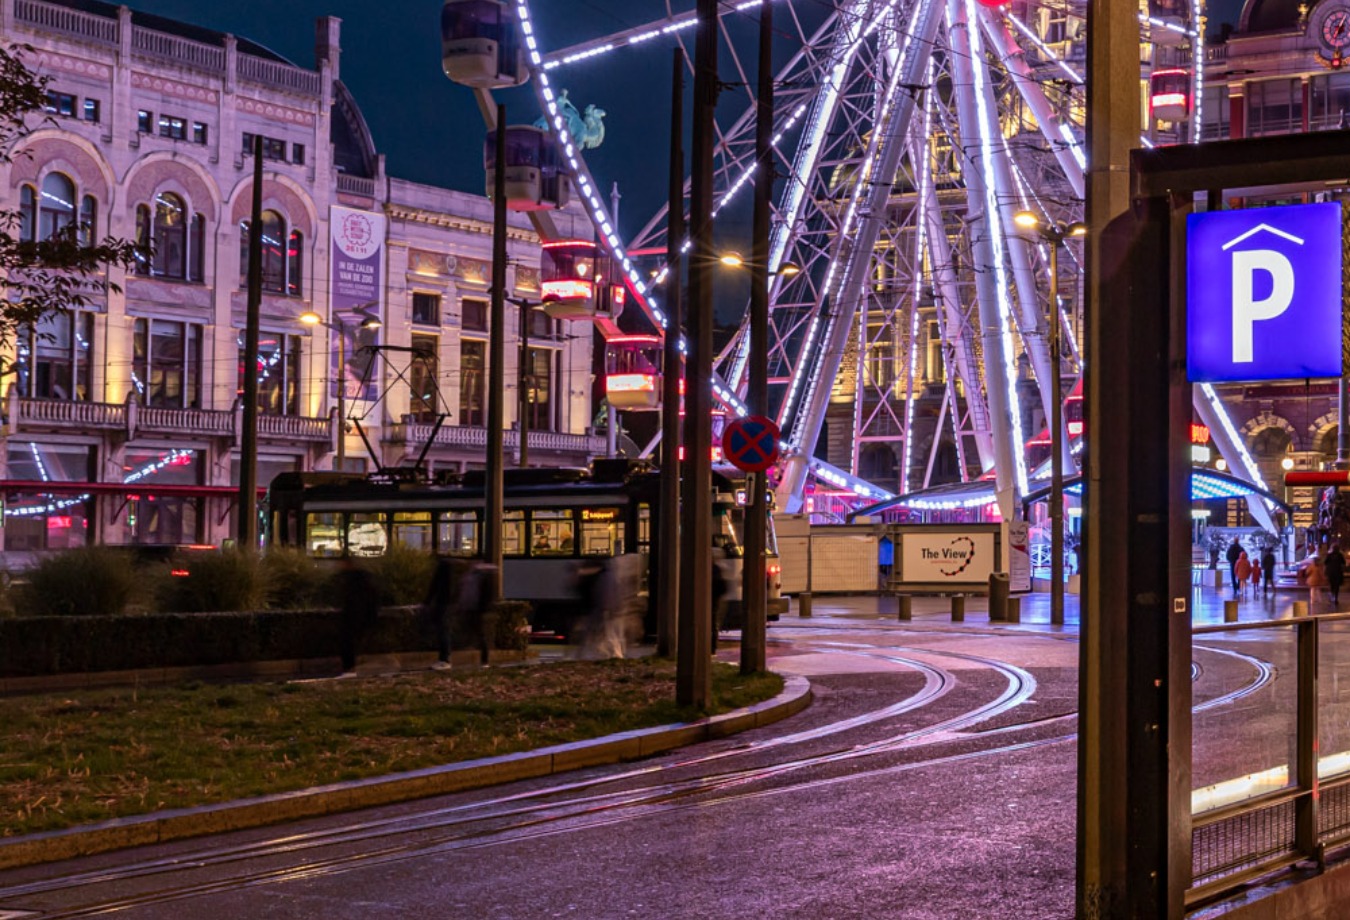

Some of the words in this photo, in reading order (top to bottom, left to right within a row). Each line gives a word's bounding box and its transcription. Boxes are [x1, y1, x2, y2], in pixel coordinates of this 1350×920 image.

[338, 261, 346, 270] IN
[346, 262, 355, 271] DE
[355, 264, 374, 274] ZALEN
[339, 271, 352, 281] VAN
[353, 273, 361, 282] DE
[1232, 249, 1295, 363] P
[921, 548, 939, 559] The
[942, 548, 967, 559] View
